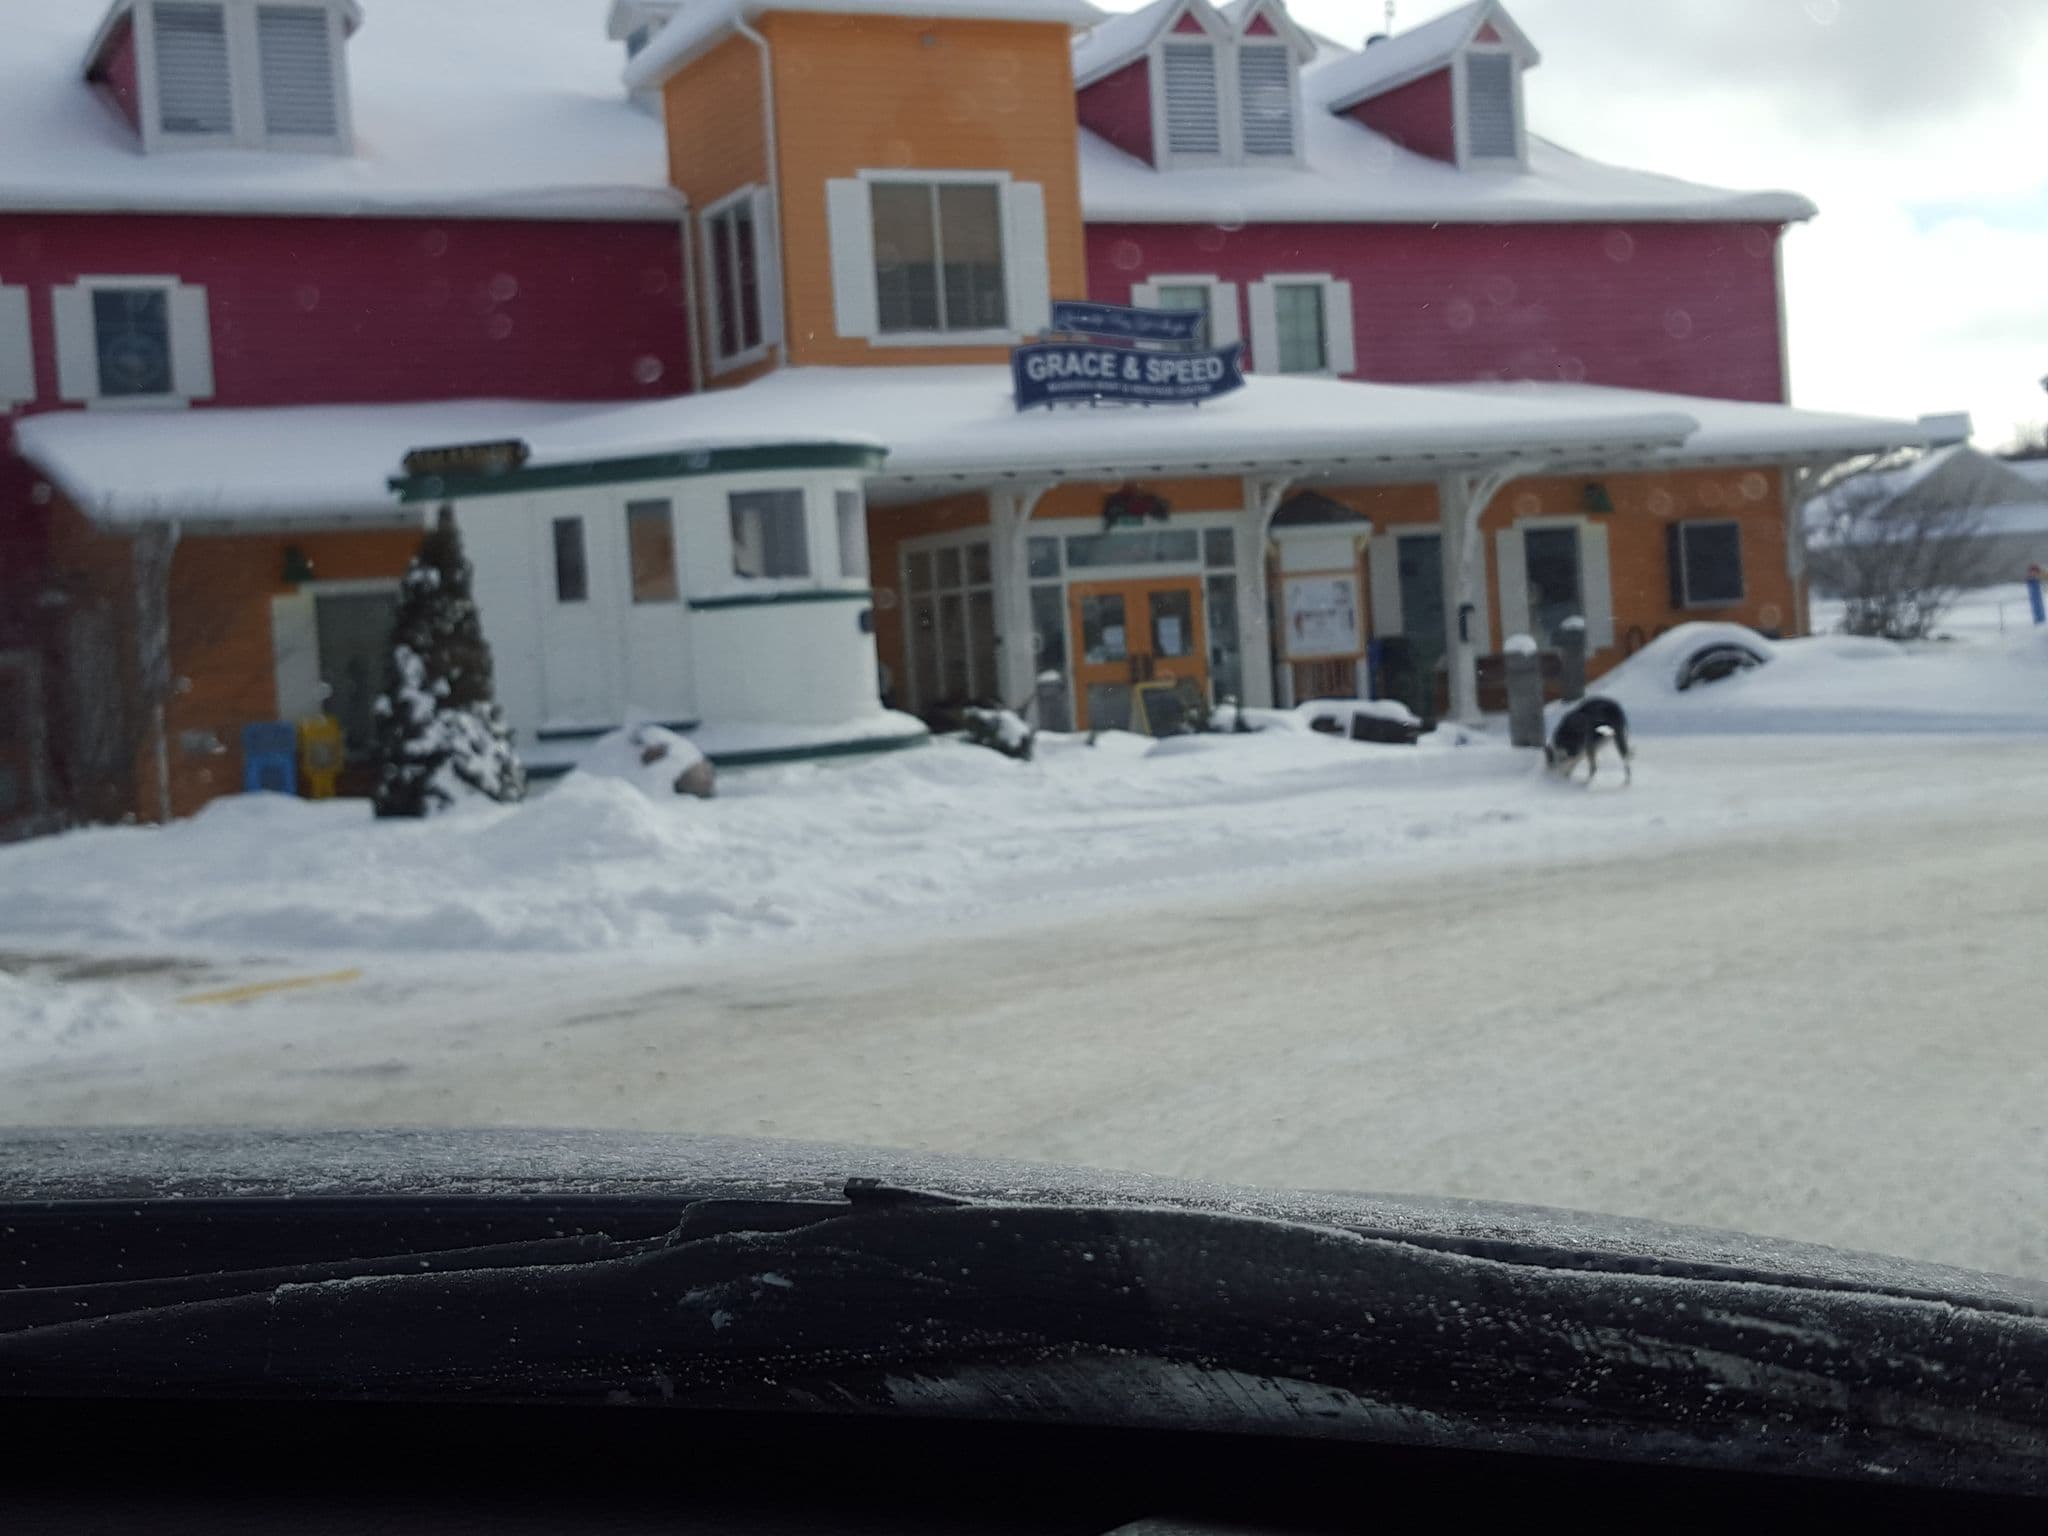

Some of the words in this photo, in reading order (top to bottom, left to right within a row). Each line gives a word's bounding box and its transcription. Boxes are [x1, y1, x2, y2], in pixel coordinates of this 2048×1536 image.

[1027, 352, 1116, 381] GRACE
[1123, 355, 1139, 380] &
[1146, 357, 1224, 383] SPEED
